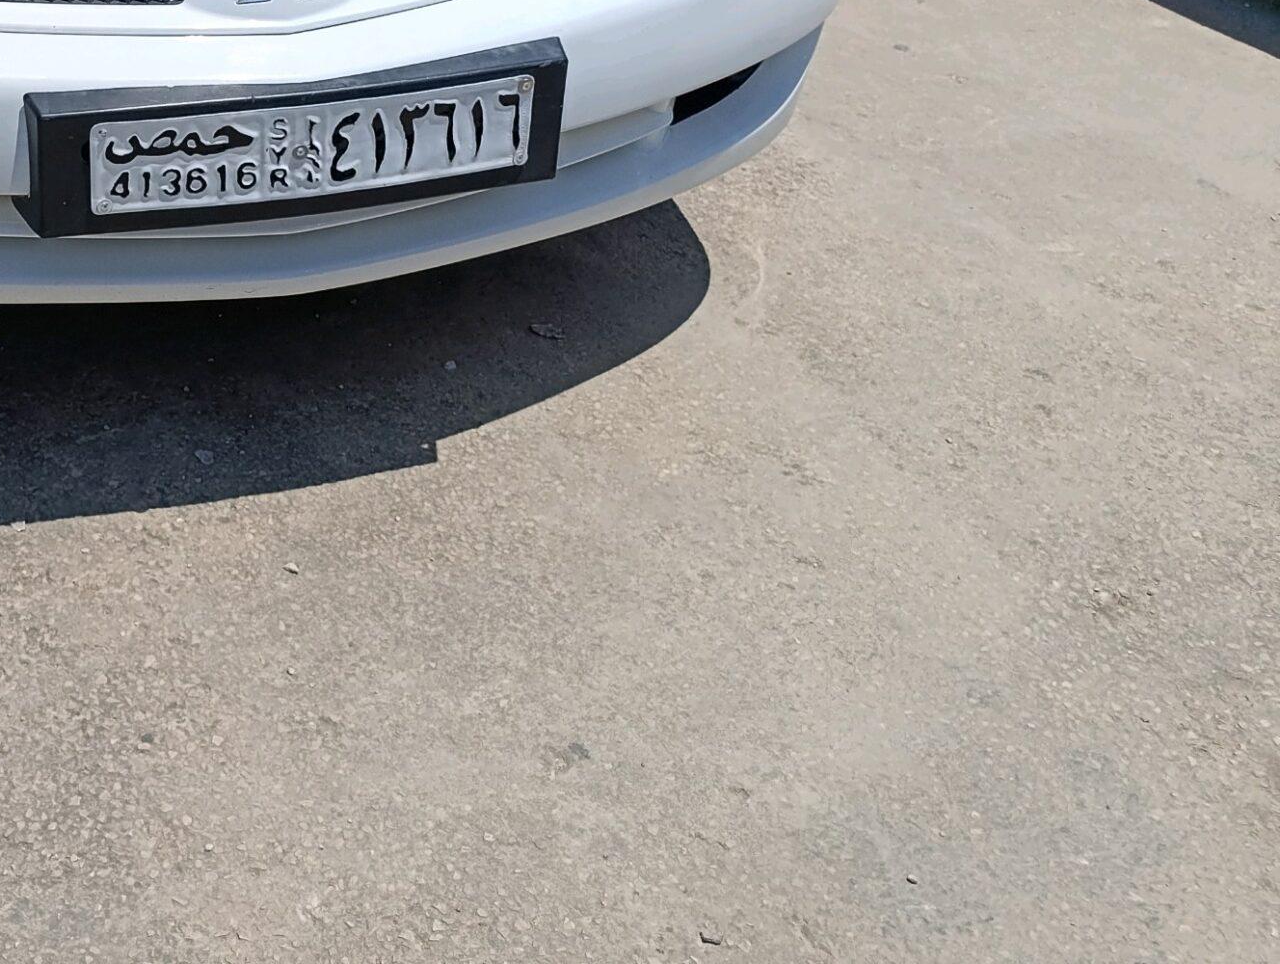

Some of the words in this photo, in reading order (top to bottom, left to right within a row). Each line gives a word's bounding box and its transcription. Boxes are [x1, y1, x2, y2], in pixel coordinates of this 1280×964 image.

[105, 125, 254, 164] حمص
[330, 93, 520, 182] ٤١٣٦١٦
[110, 162, 258, 198] 413616
